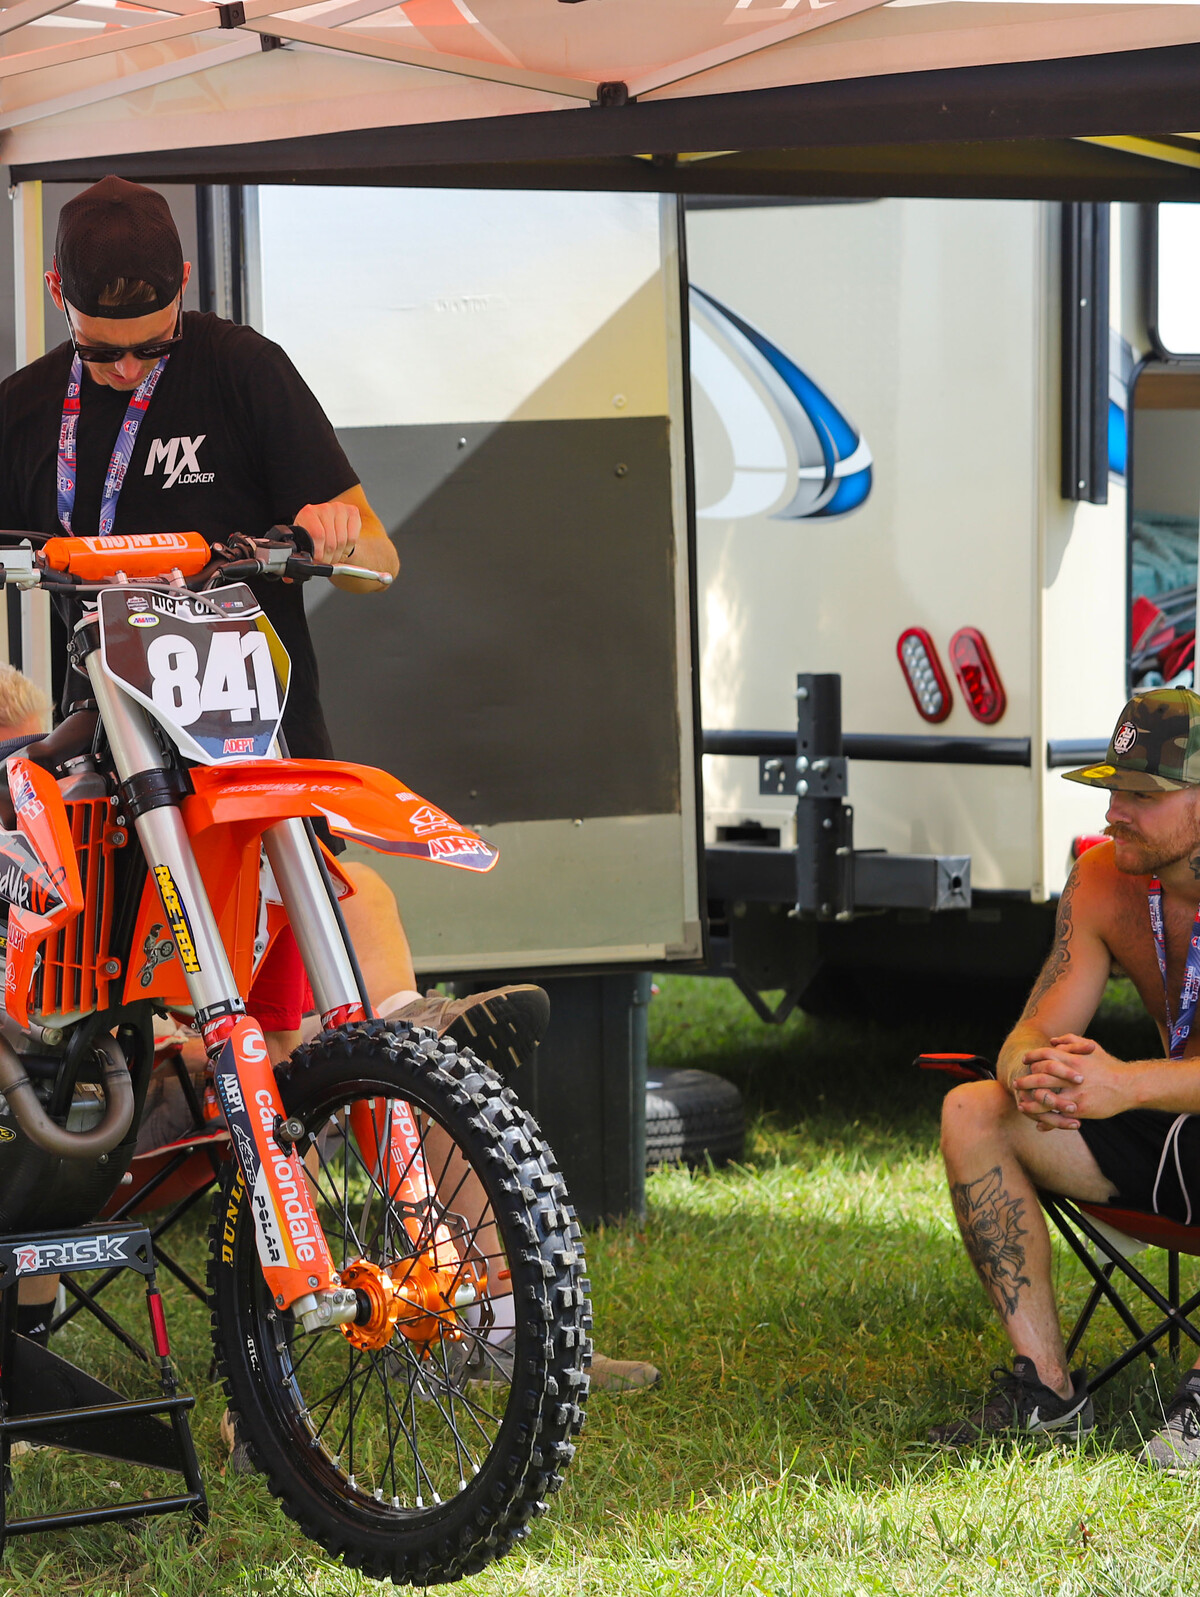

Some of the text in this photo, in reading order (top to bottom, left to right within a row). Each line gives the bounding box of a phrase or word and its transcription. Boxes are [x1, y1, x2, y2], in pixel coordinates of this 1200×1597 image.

[144, 434, 207, 489] MX
[178, 472, 215, 484] LOCKER
[147, 631, 280, 727] 841
[222, 738, 255, 753] ADEPT
[428, 836, 492, 859] ADEPT
[155, 865, 200, 973] RACE TECH
[204, 1018, 226, 1036] WP
[221, 1074, 245, 1114] ADEPT
[254, 1195, 280, 1262] POLAR
